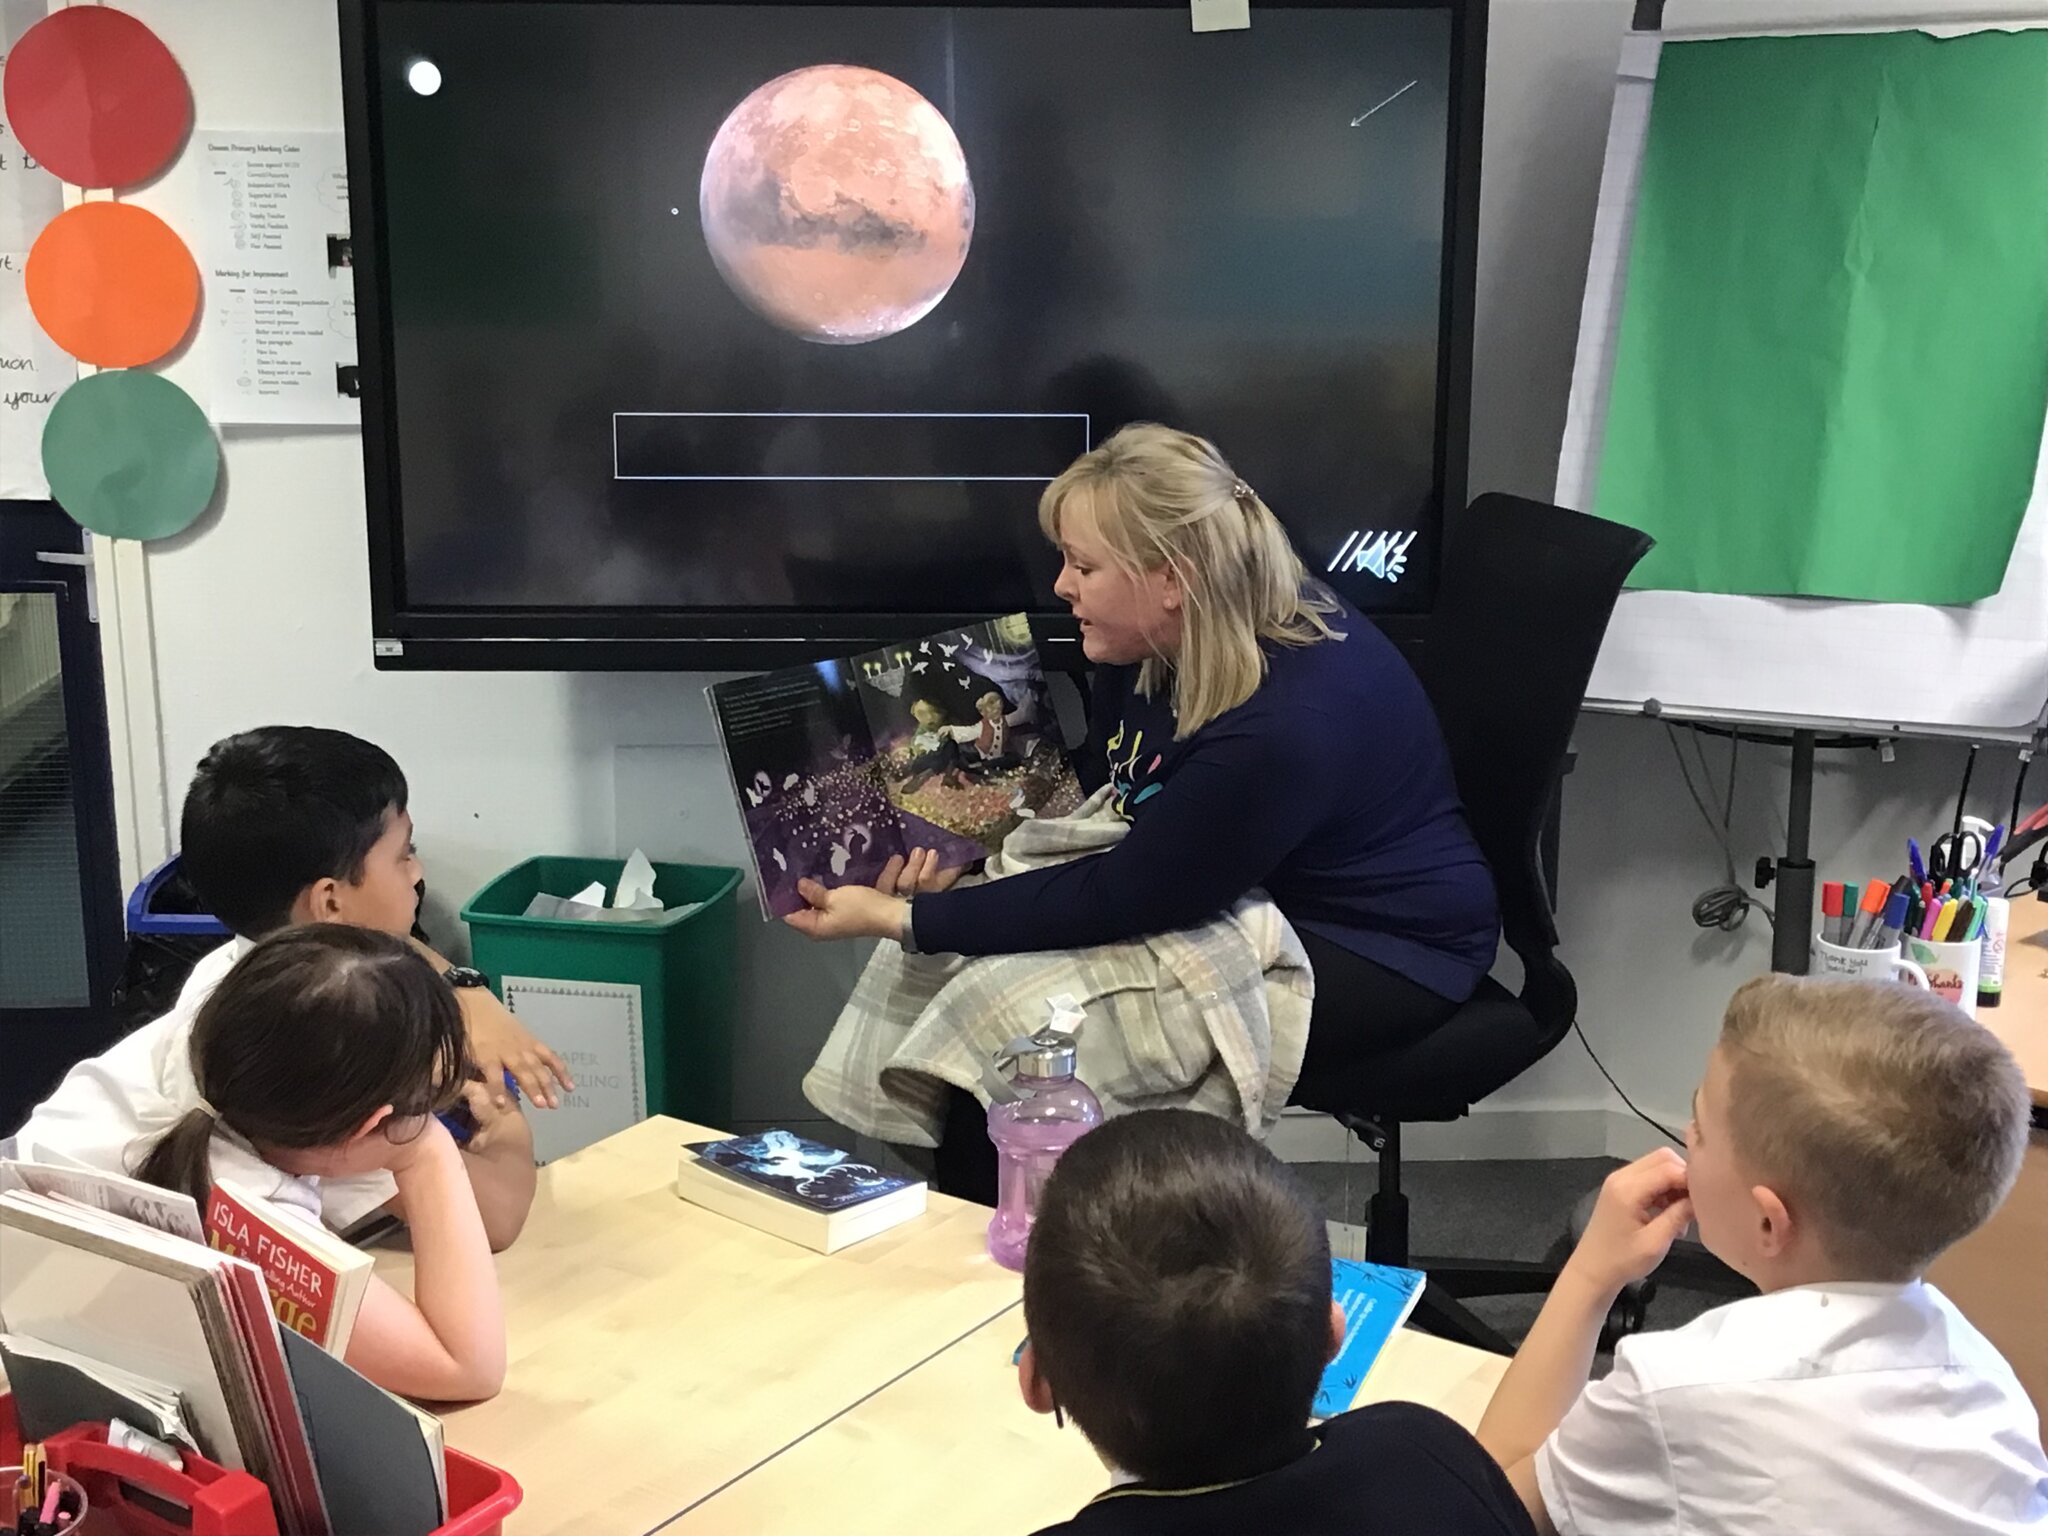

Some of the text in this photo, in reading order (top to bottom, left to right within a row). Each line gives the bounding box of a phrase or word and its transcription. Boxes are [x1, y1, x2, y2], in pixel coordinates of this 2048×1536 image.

[231, 144, 256, 154] Primary
[257, 144, 281, 154] Marking
[215, 269, 288, 279] Marking for Improvement
[3, 391, 57, 411] your
[213, 1201, 250, 1247] ISLA
[257, 1233, 323, 1298] FISHER
